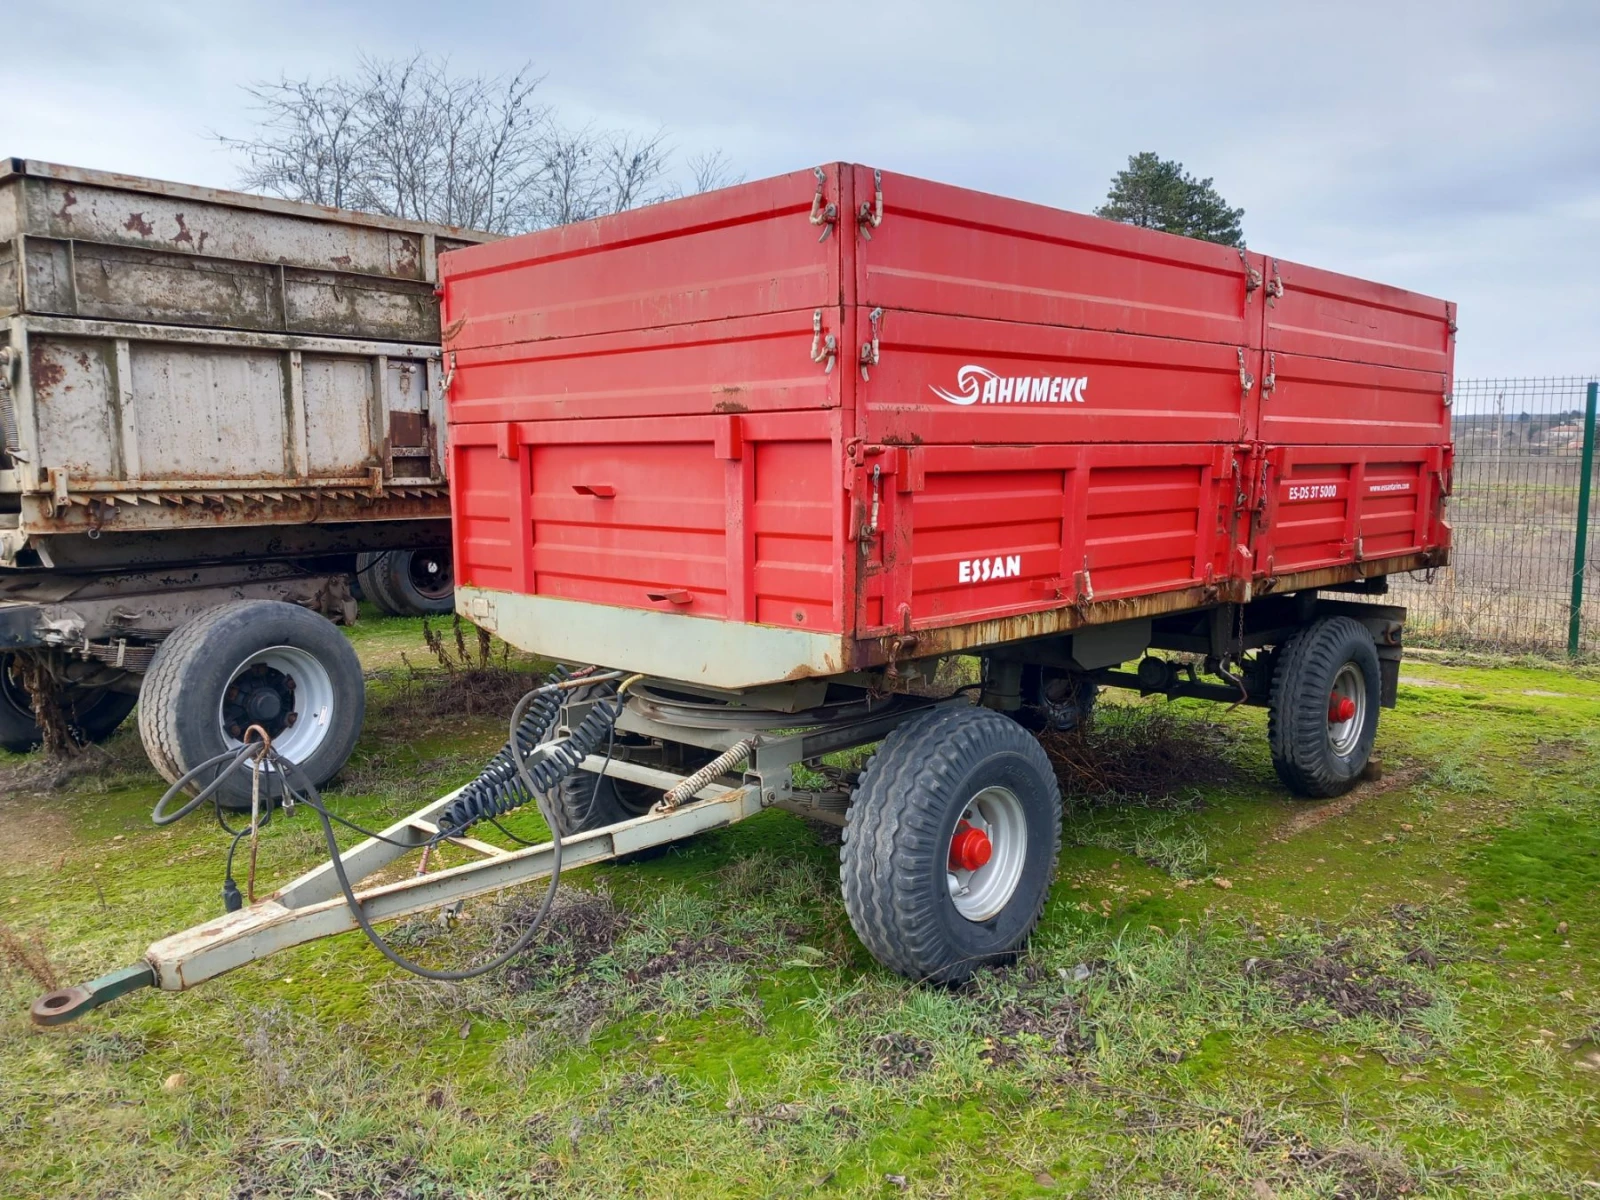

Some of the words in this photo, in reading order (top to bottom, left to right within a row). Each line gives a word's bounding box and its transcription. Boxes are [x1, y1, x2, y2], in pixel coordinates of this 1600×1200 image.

[981, 376, 1088, 404] АНИМЕКС
[1289, 486, 1309, 500] ES-DS
[1310, 486, 1319, 498] 3T
[1319, 485, 1337, 498] 5000
[958, 555, 1021, 583] ESSAN
